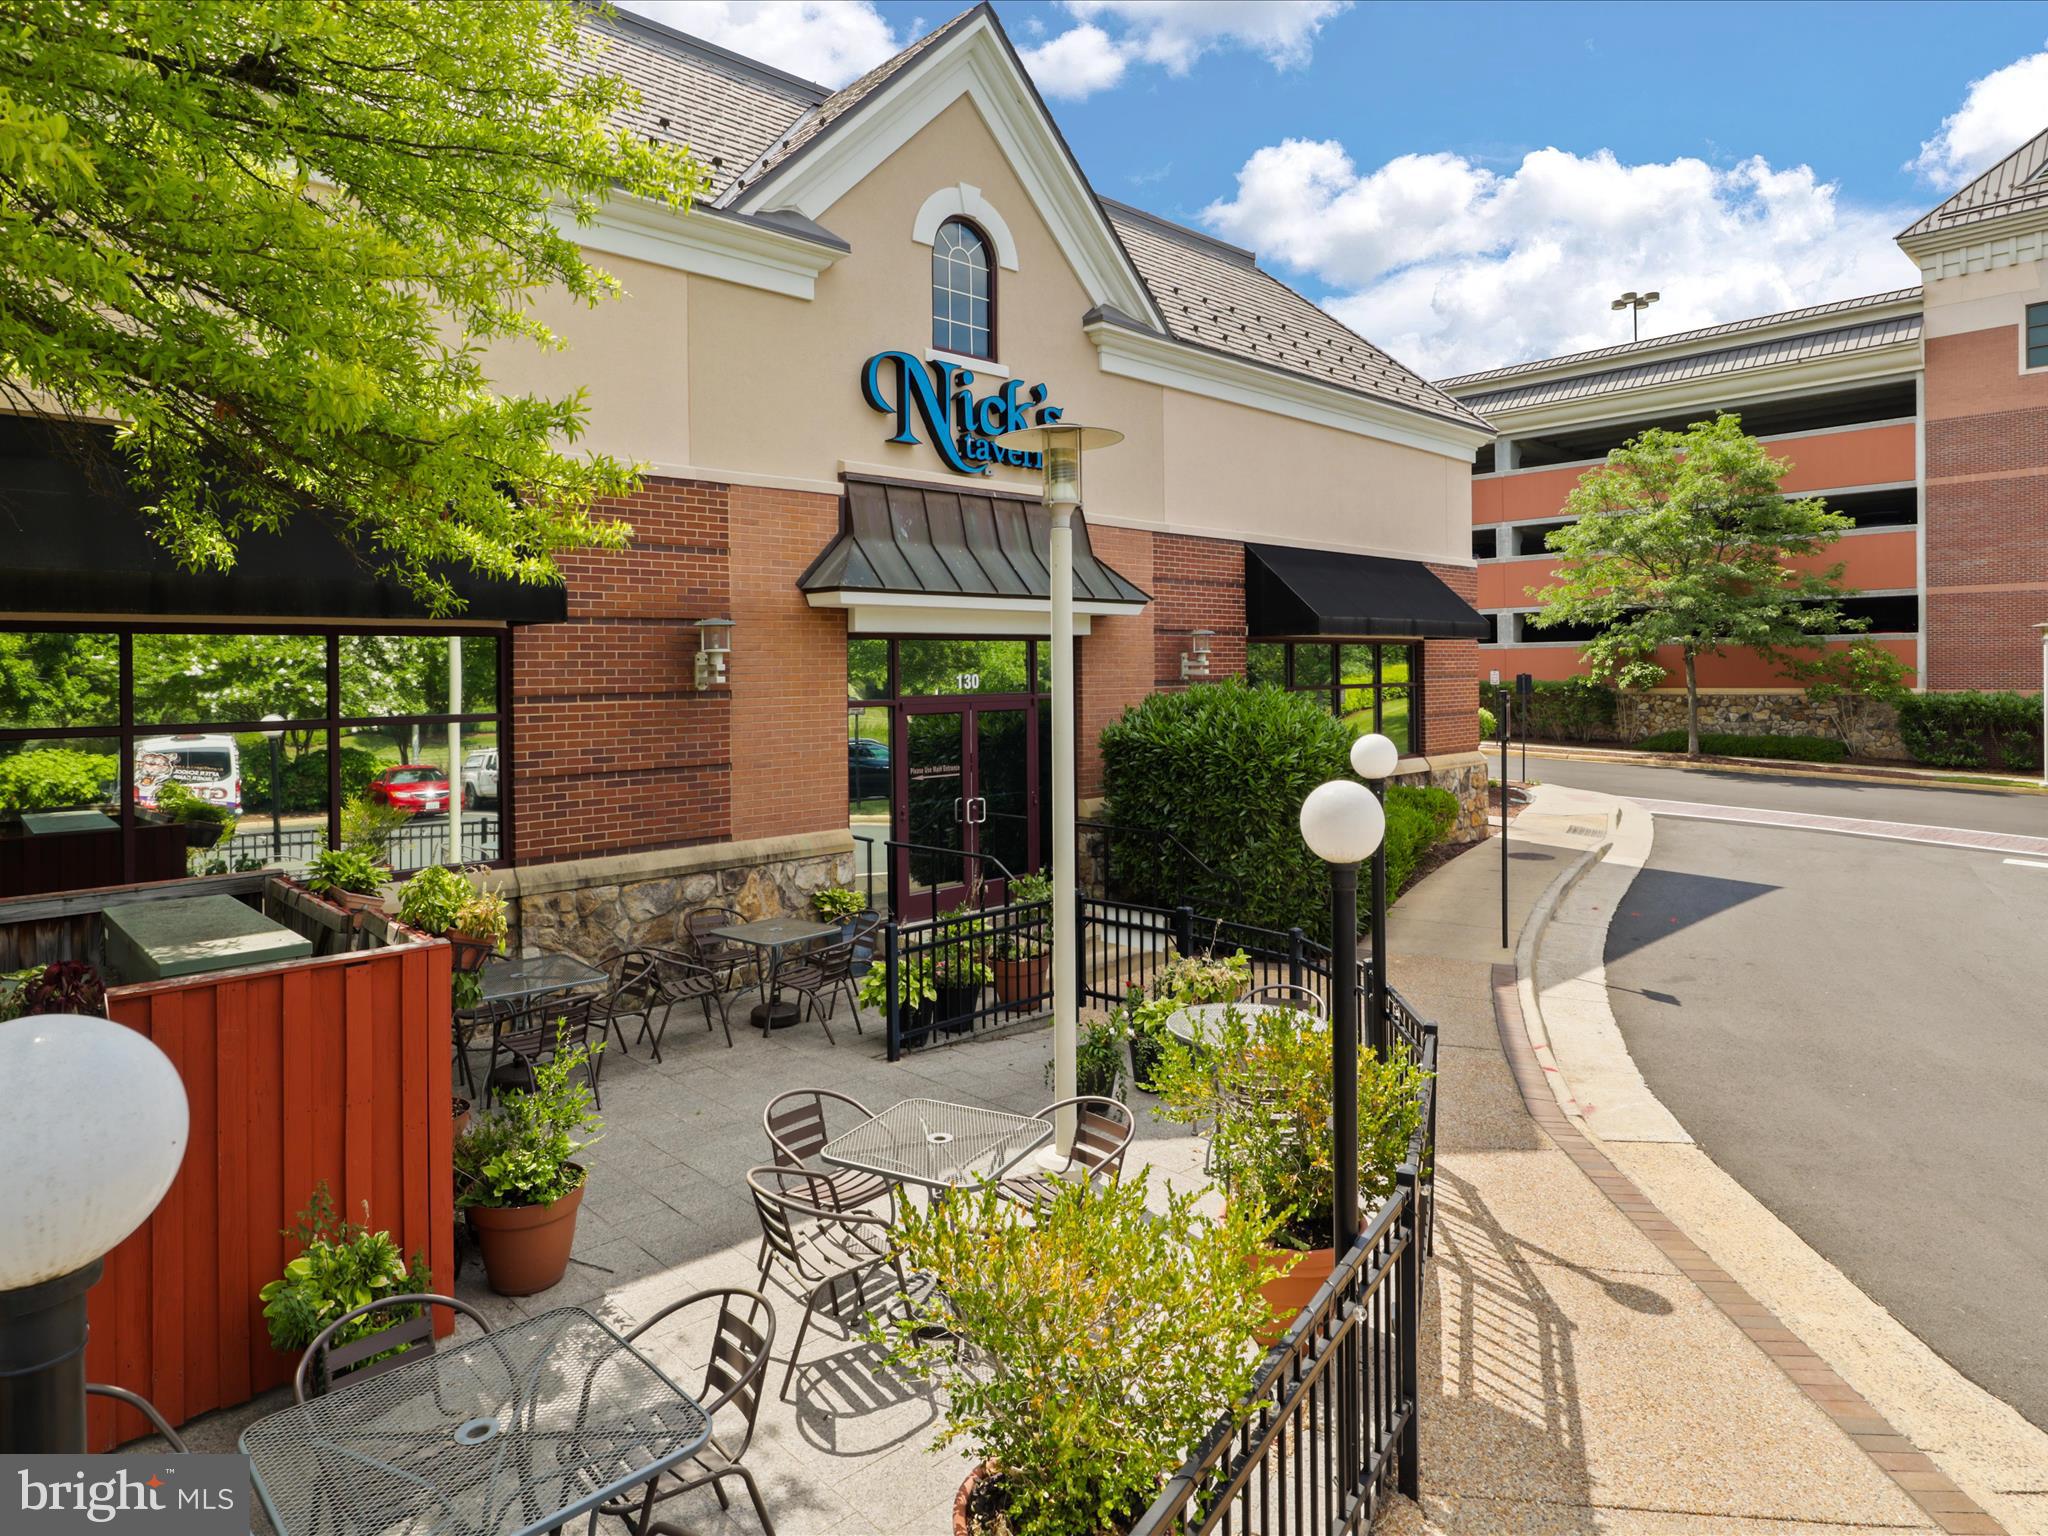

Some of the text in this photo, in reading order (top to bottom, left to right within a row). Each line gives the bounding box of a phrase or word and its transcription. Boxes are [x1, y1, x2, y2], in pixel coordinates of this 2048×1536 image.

[956, 673, 980, 690] 130
[910, 764, 960, 775] Please Use Main Entrance
